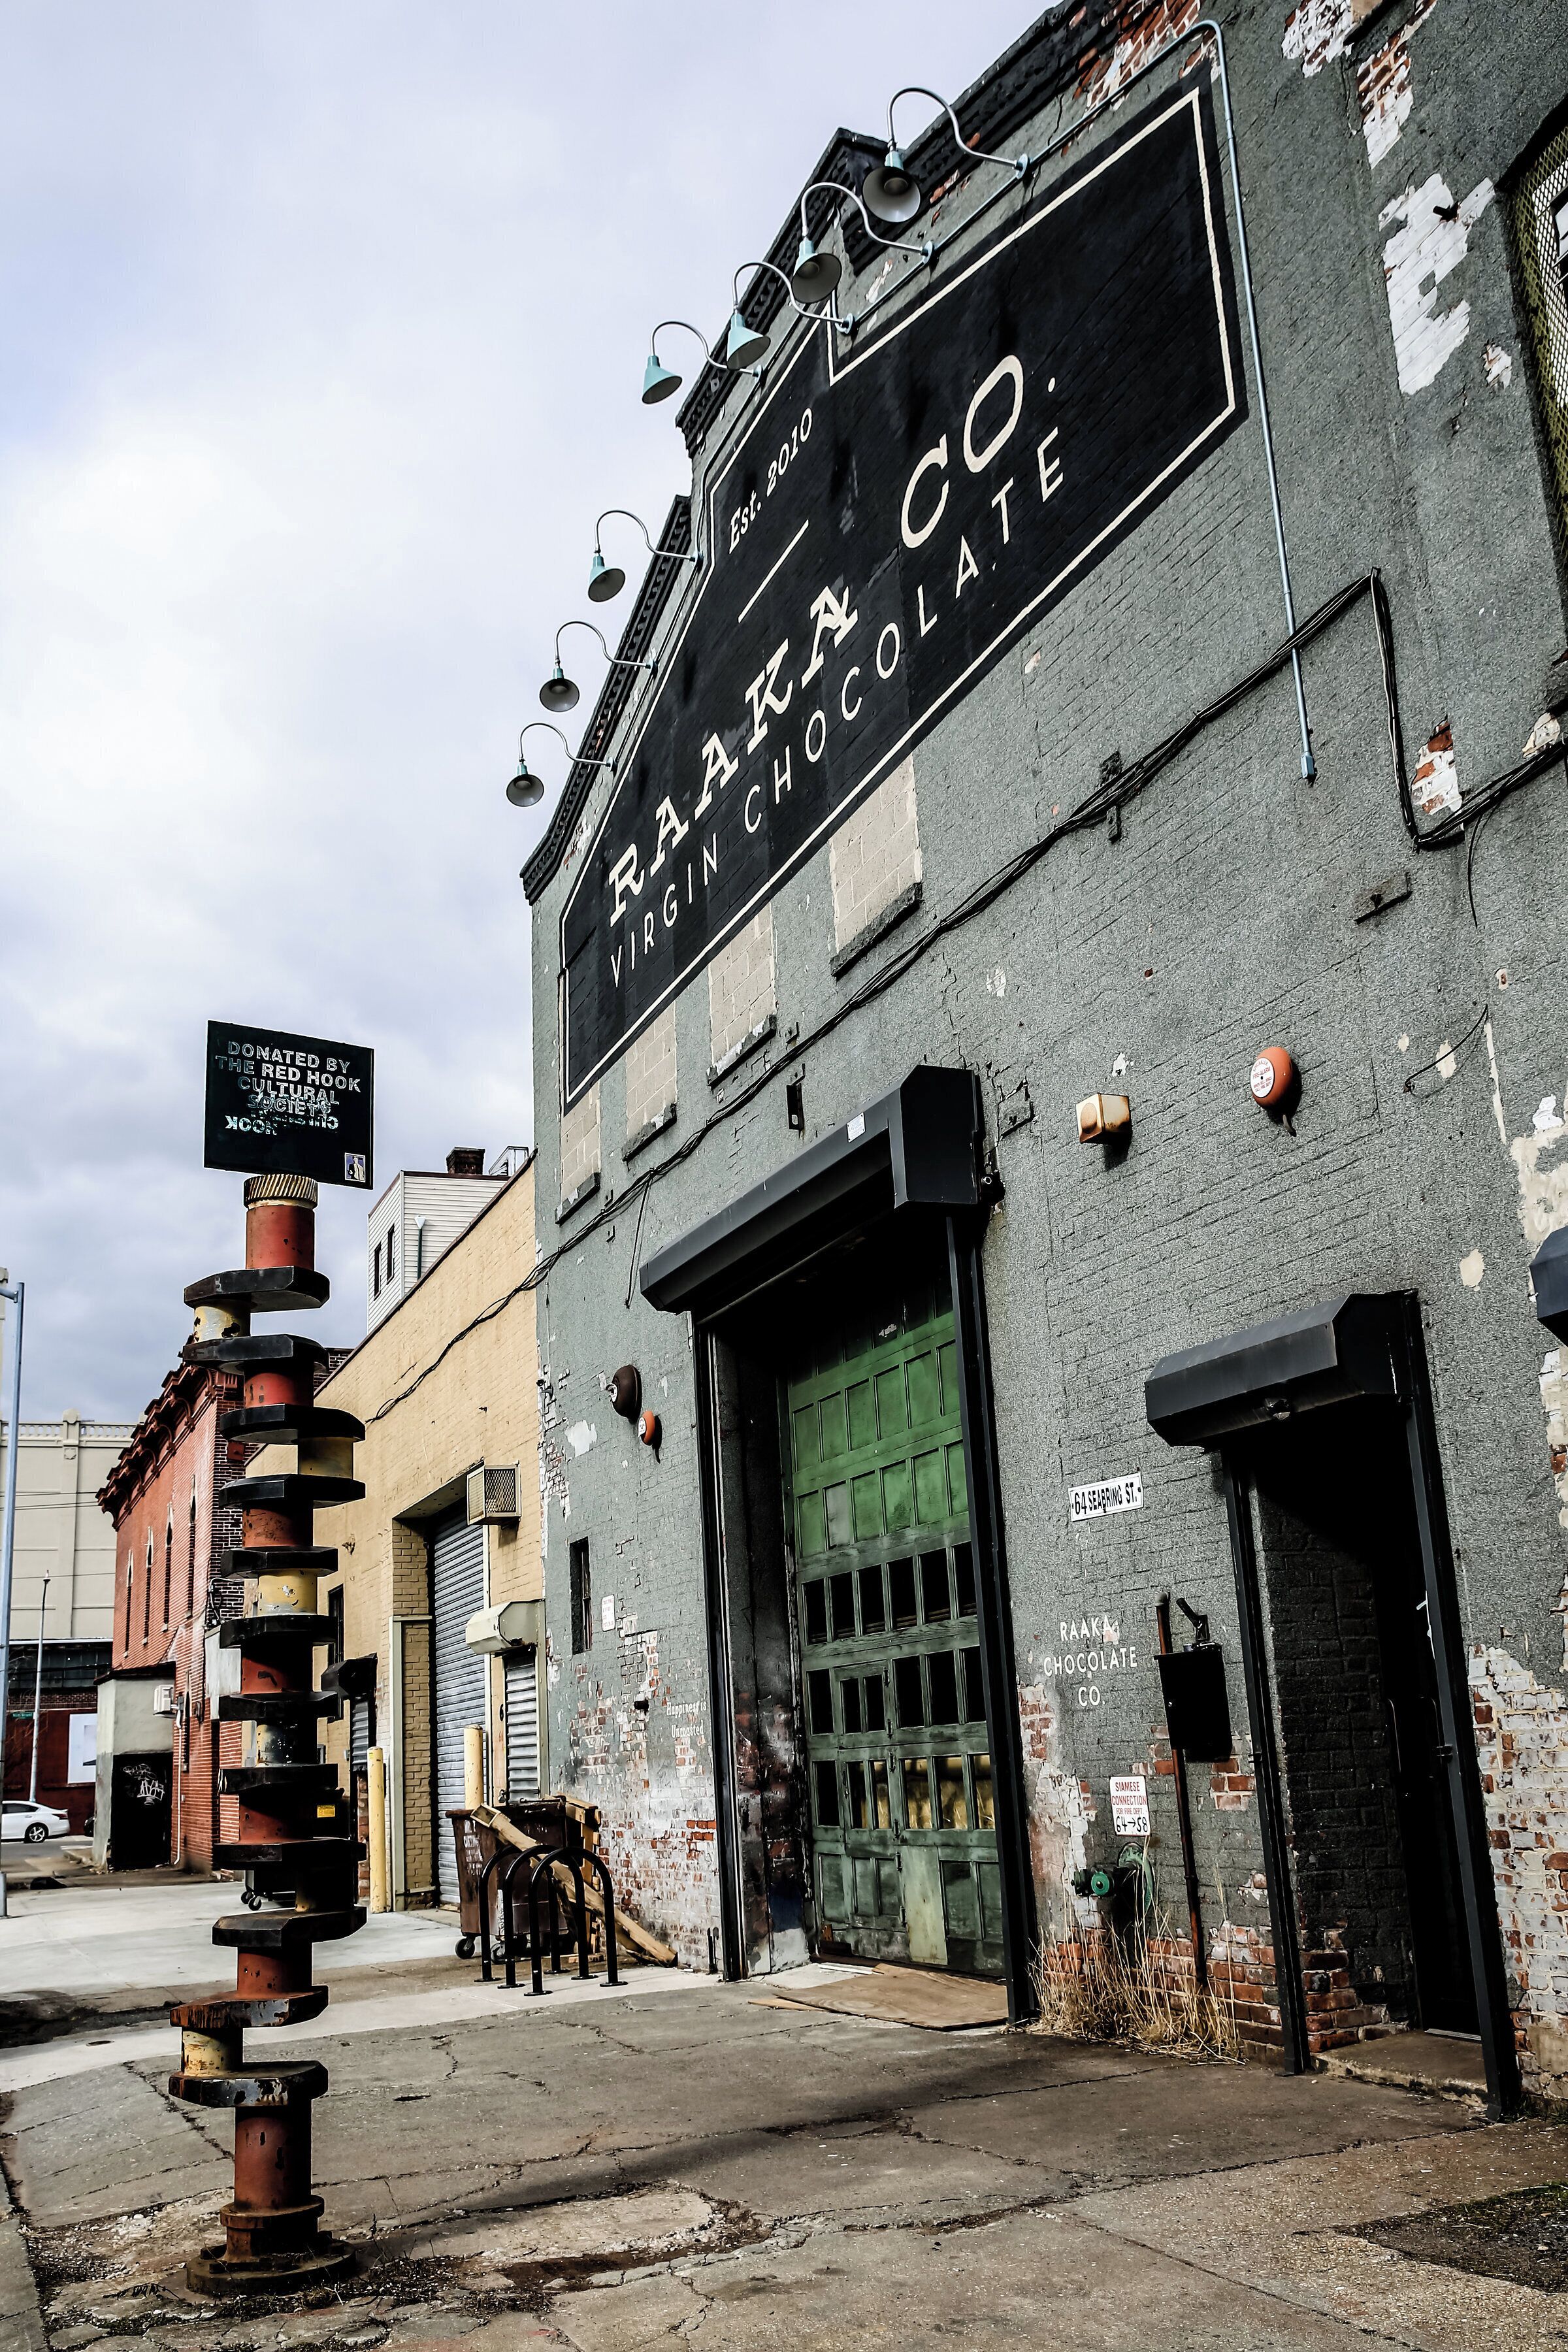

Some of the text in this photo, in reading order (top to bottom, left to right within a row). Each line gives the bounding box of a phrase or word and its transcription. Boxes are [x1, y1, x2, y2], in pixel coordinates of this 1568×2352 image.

[728, 408, 812, 554] Est. 2010
[608, 355, 1056, 928] RAAKA CO.
[611, 426, 1064, 988] VIRGIN CHOCOLATE
[228, 1041, 350, 1073] DONATED BY
[215, 1055, 361, 1092] THE RED HOOK
[238, 1076, 340, 1105] CULTURAL
[247, 1094, 331, 1118] SOCIETY
[1074, 1482, 1137, 1515] 64 SEABRING ST.
[1060, 1614, 1115, 1642] RAAKA
[1043, 1646, 1137, 1677] CHOCOLATE
[666, 1698, 707, 1718] Happiness is
[1078, 1685, 1105, 1707] CO.
[672, 1720, 704, 1738] Unroasted
[1111, 1795, 1147, 1805] CONNECTION
[1115, 1782, 1140, 1791] SIAMESE
[1116, 1816, 1148, 1833] 64 58
